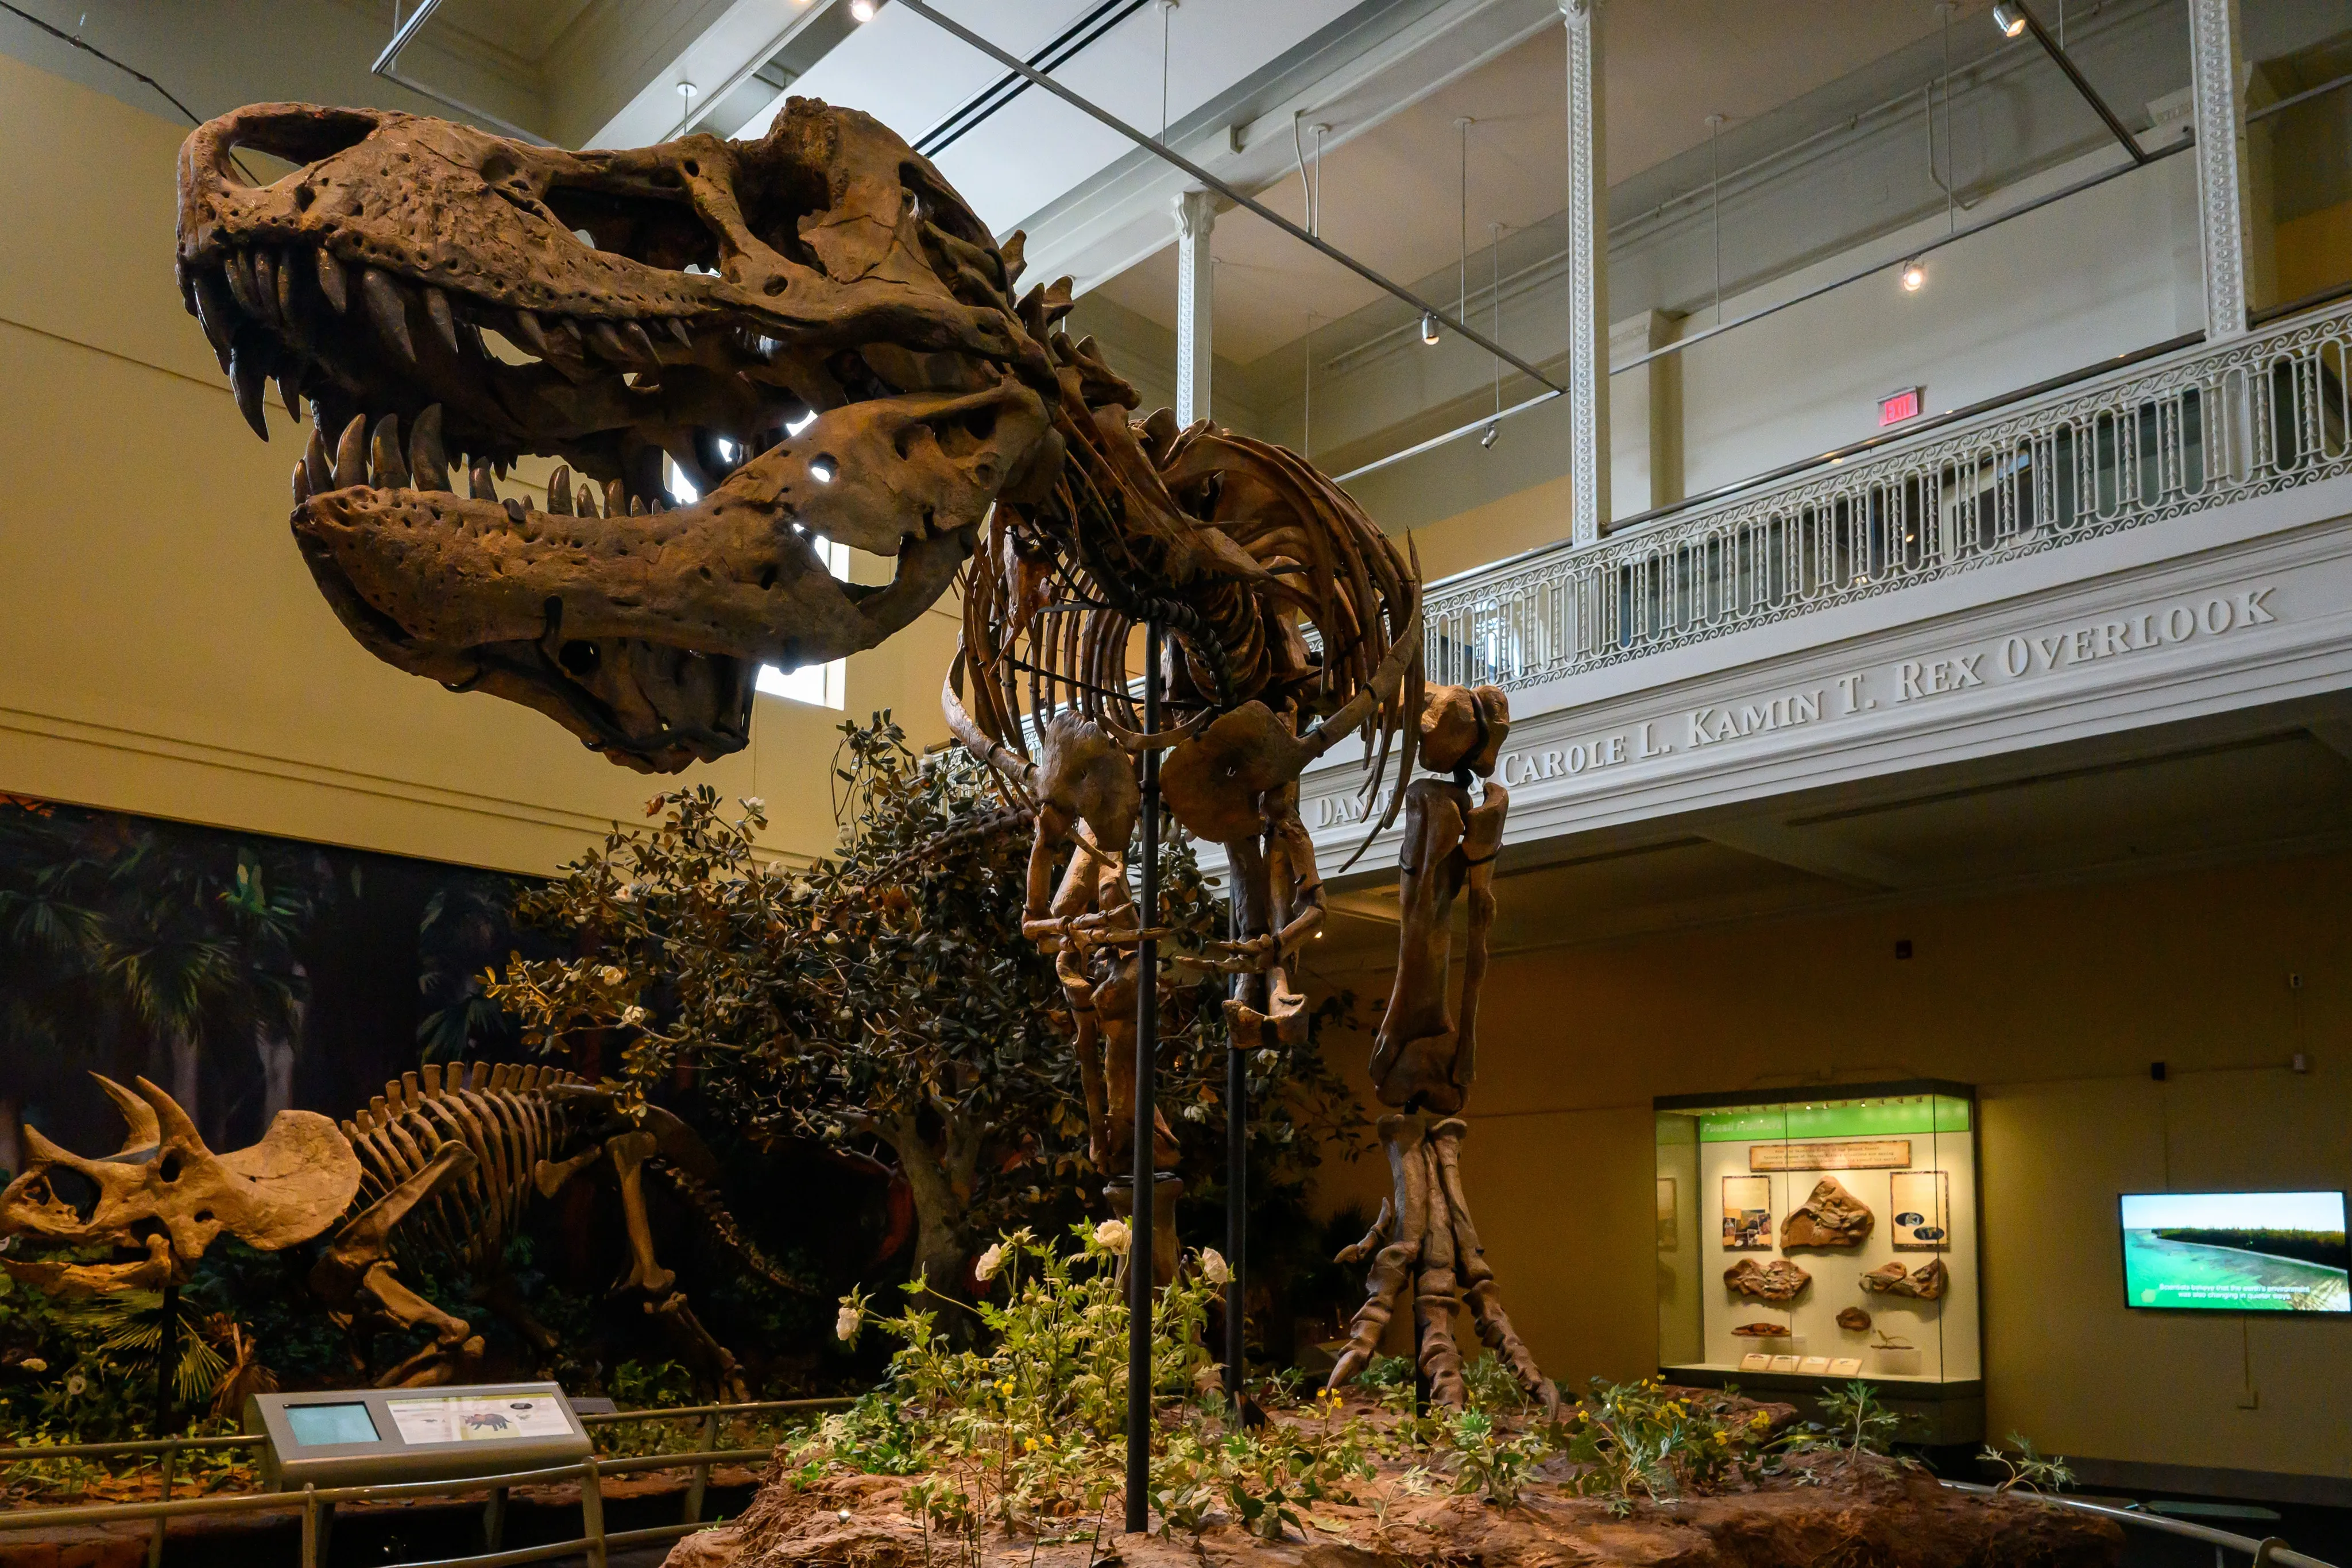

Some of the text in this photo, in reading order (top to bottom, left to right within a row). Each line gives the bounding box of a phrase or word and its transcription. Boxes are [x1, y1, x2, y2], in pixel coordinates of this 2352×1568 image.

[1885, 393, 1911, 422] EXIT
[1499, 734, 1627, 787] CAROLE
[1637, 720, 1672, 759] L.
[1686, 690, 1824, 748] KAMIN
[1839, 673, 1876, 715] T.
[1893, 653, 1985, 703] REX
[1997, 587, 2277, 678] OVERLOOK
